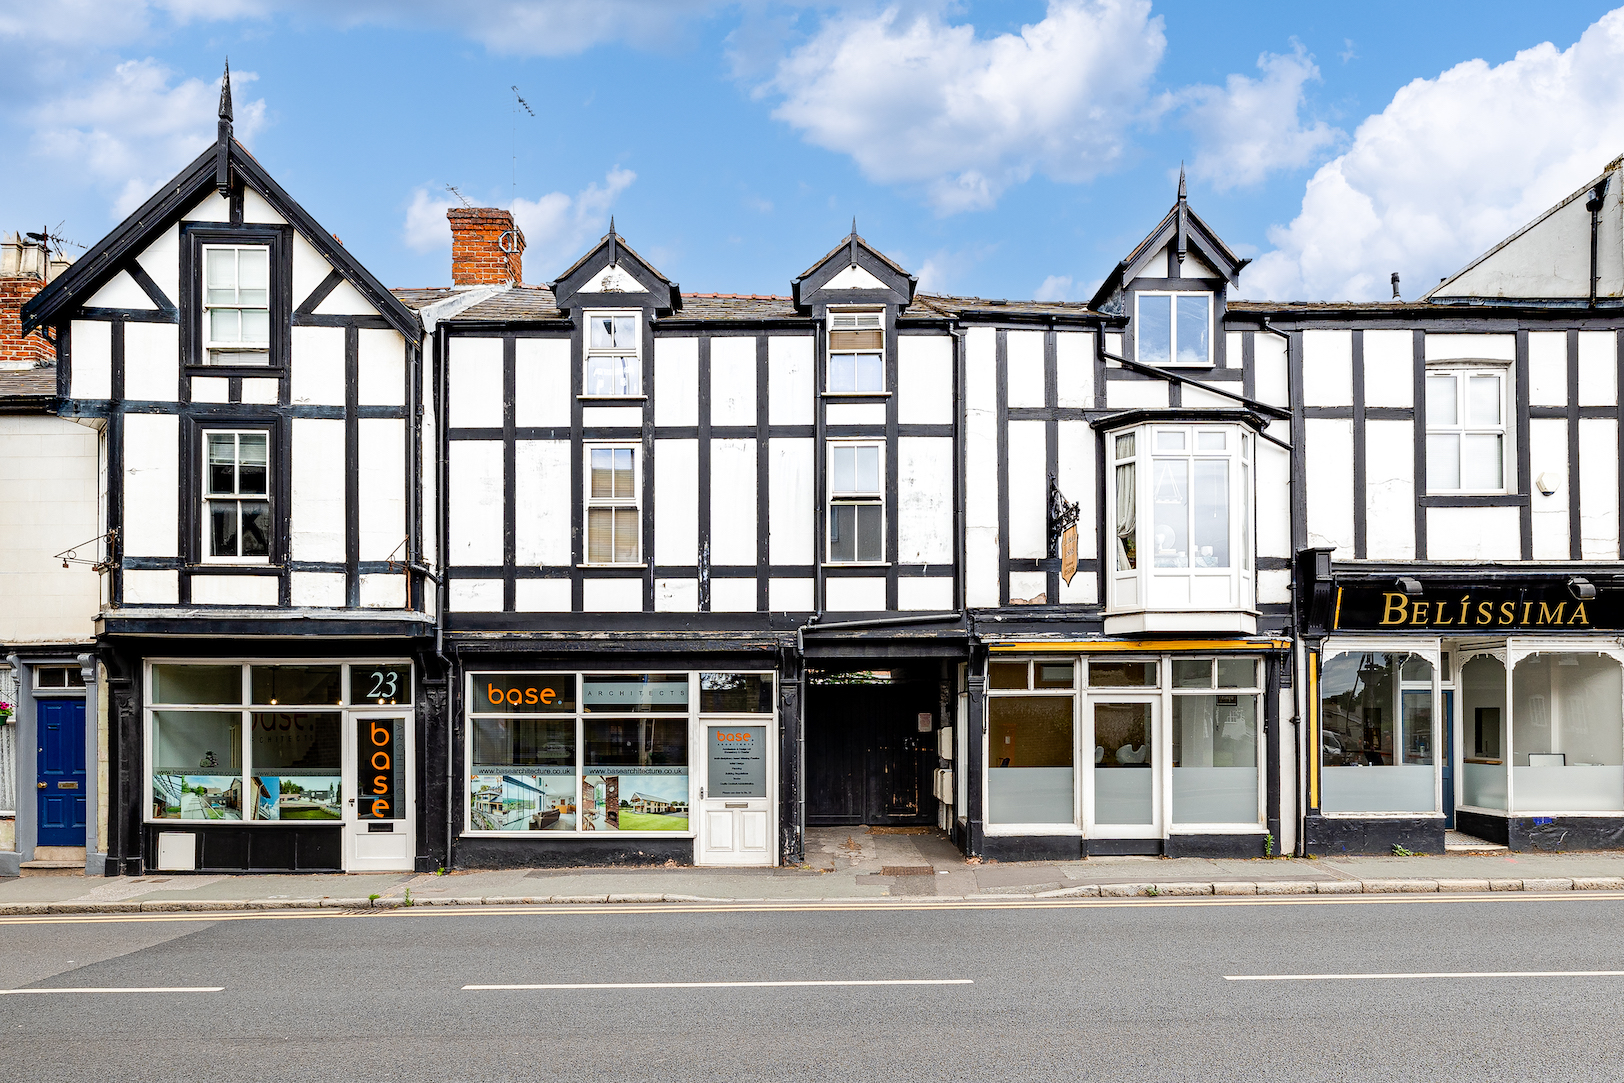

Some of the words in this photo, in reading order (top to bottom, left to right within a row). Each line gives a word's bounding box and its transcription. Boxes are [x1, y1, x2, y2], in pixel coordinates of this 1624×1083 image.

[1379, 592, 1590, 625] BELÍSSIMA
[366, 671, 398, 698] 23
[370, 721, 391, 819] base
[395, 724, 405, 813] ARCHITECTS
[478, 767, 571, 775] www.basearchitecture.co.uk
[588, 767, 683, 775] www.basearchitecture.co.uk
